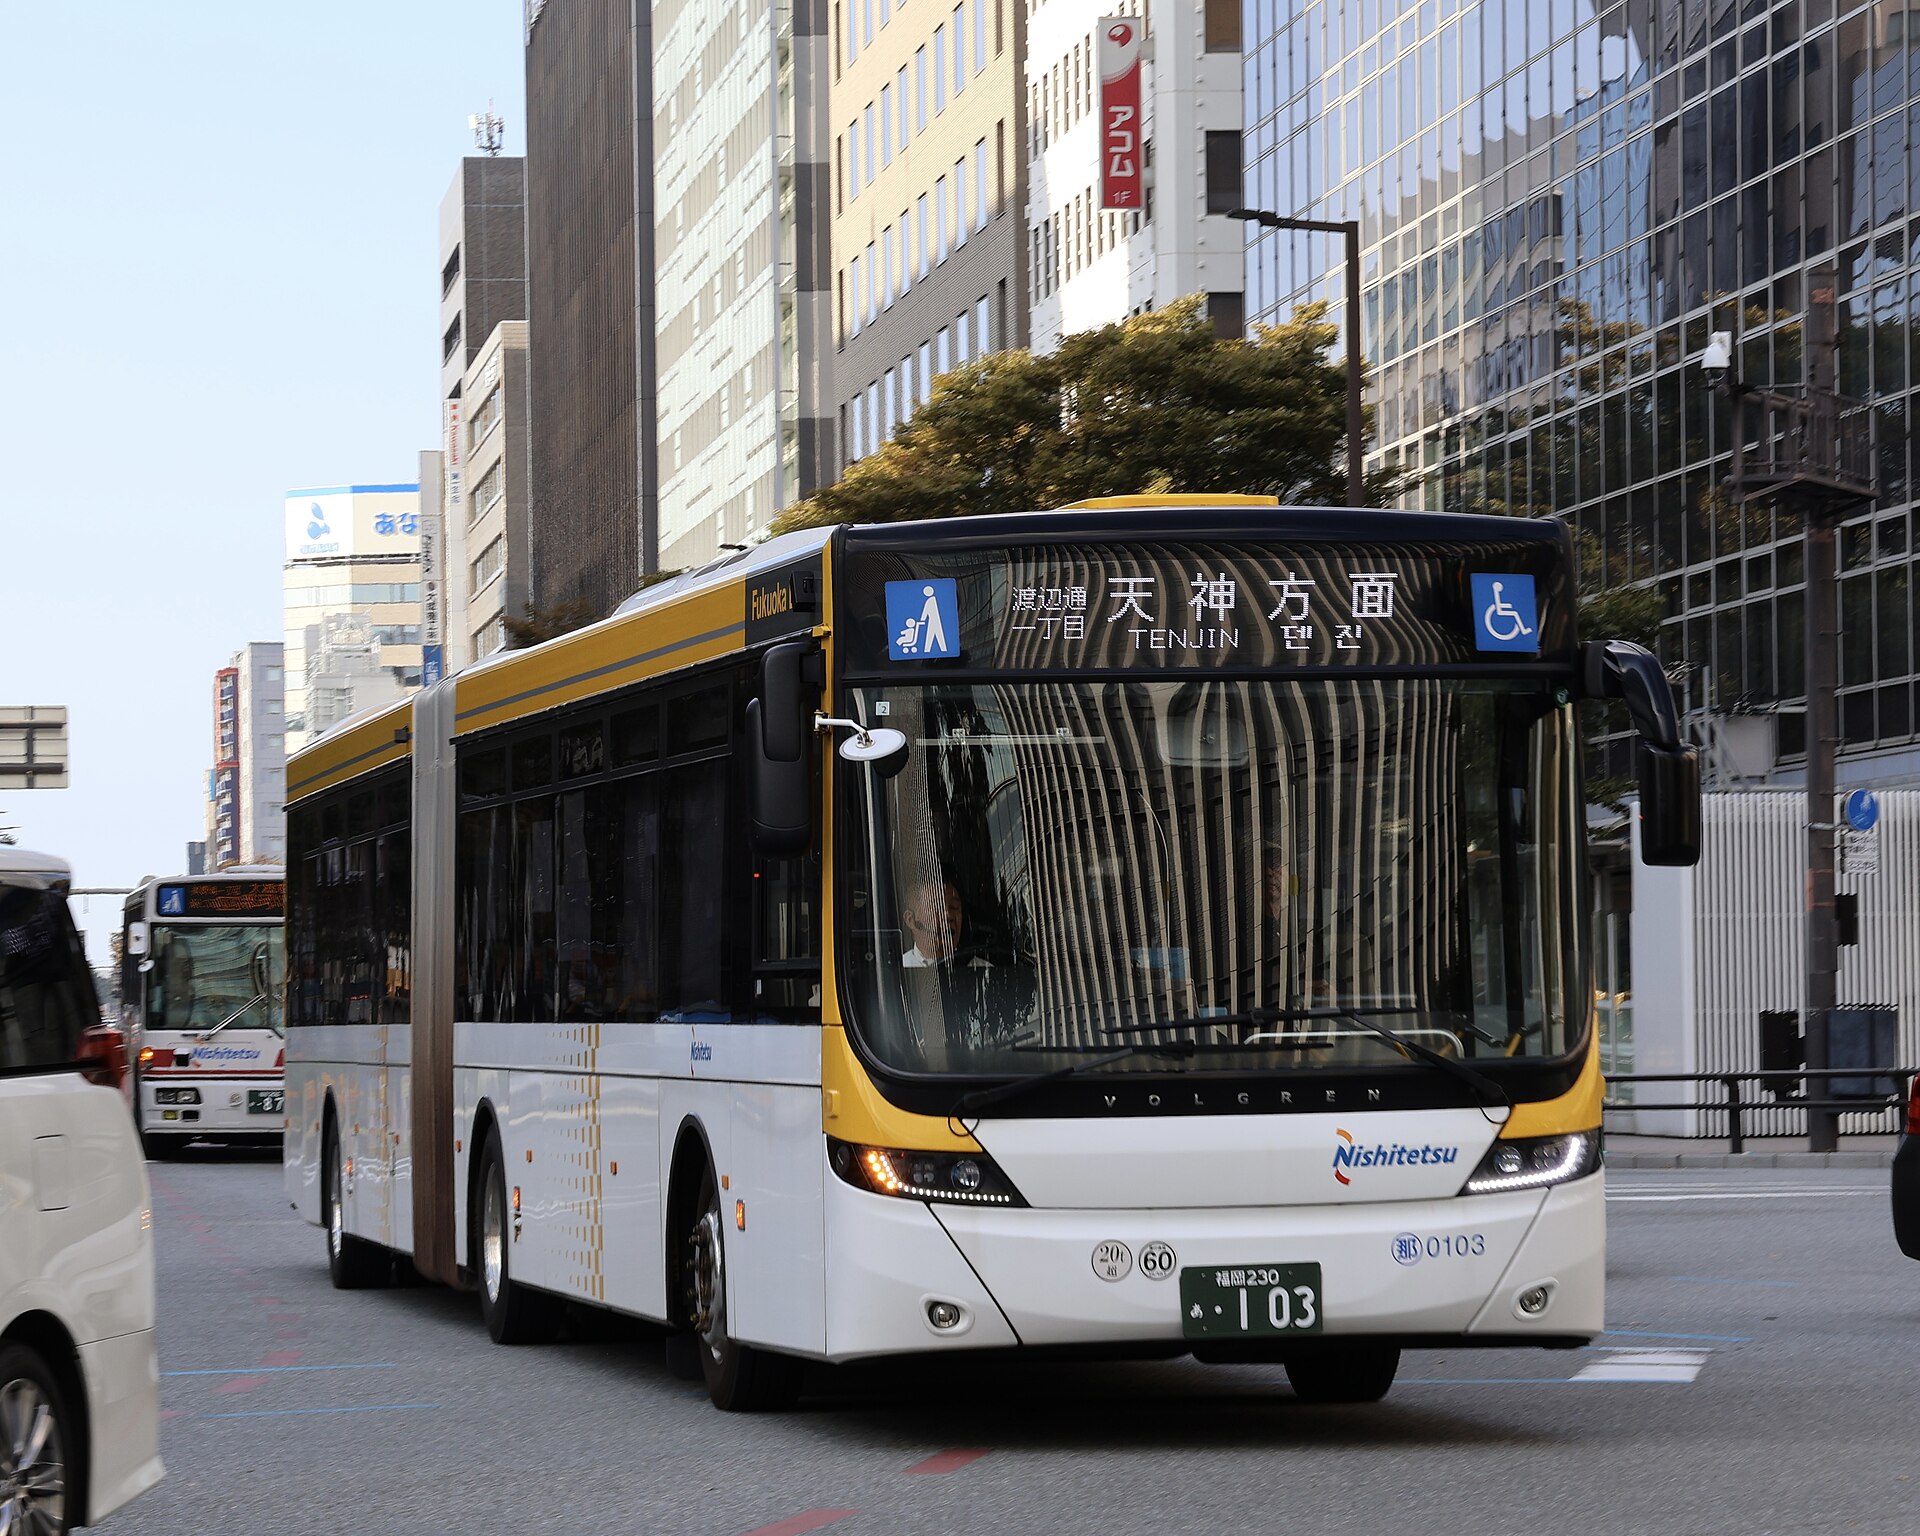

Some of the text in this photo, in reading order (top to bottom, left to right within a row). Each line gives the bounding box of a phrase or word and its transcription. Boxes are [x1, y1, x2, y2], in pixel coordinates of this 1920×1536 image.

[1108, 105, 1135, 178] アコム
[1113, 190, 1132, 204] 1F
[751, 582, 787, 621] Fukuoka
[1012, 586, 1087, 611] 渡辺通
[1107, 572, 1399, 623] 天神方面
[1012, 615, 1084, 640] 一丁目
[1128, 628, 1239, 649] TENJIN
[190, 1047, 260, 1060] Nishitetsu
[1104, 1088, 1380, 1107] VOLGREN
[1332, 1143, 1458, 1168] Nishitetsu
[1099, 1245, 1124, 1263] 20t
[1427, 1233, 1485, 1258] 0103
[1143, 1251, 1172, 1271] 60
